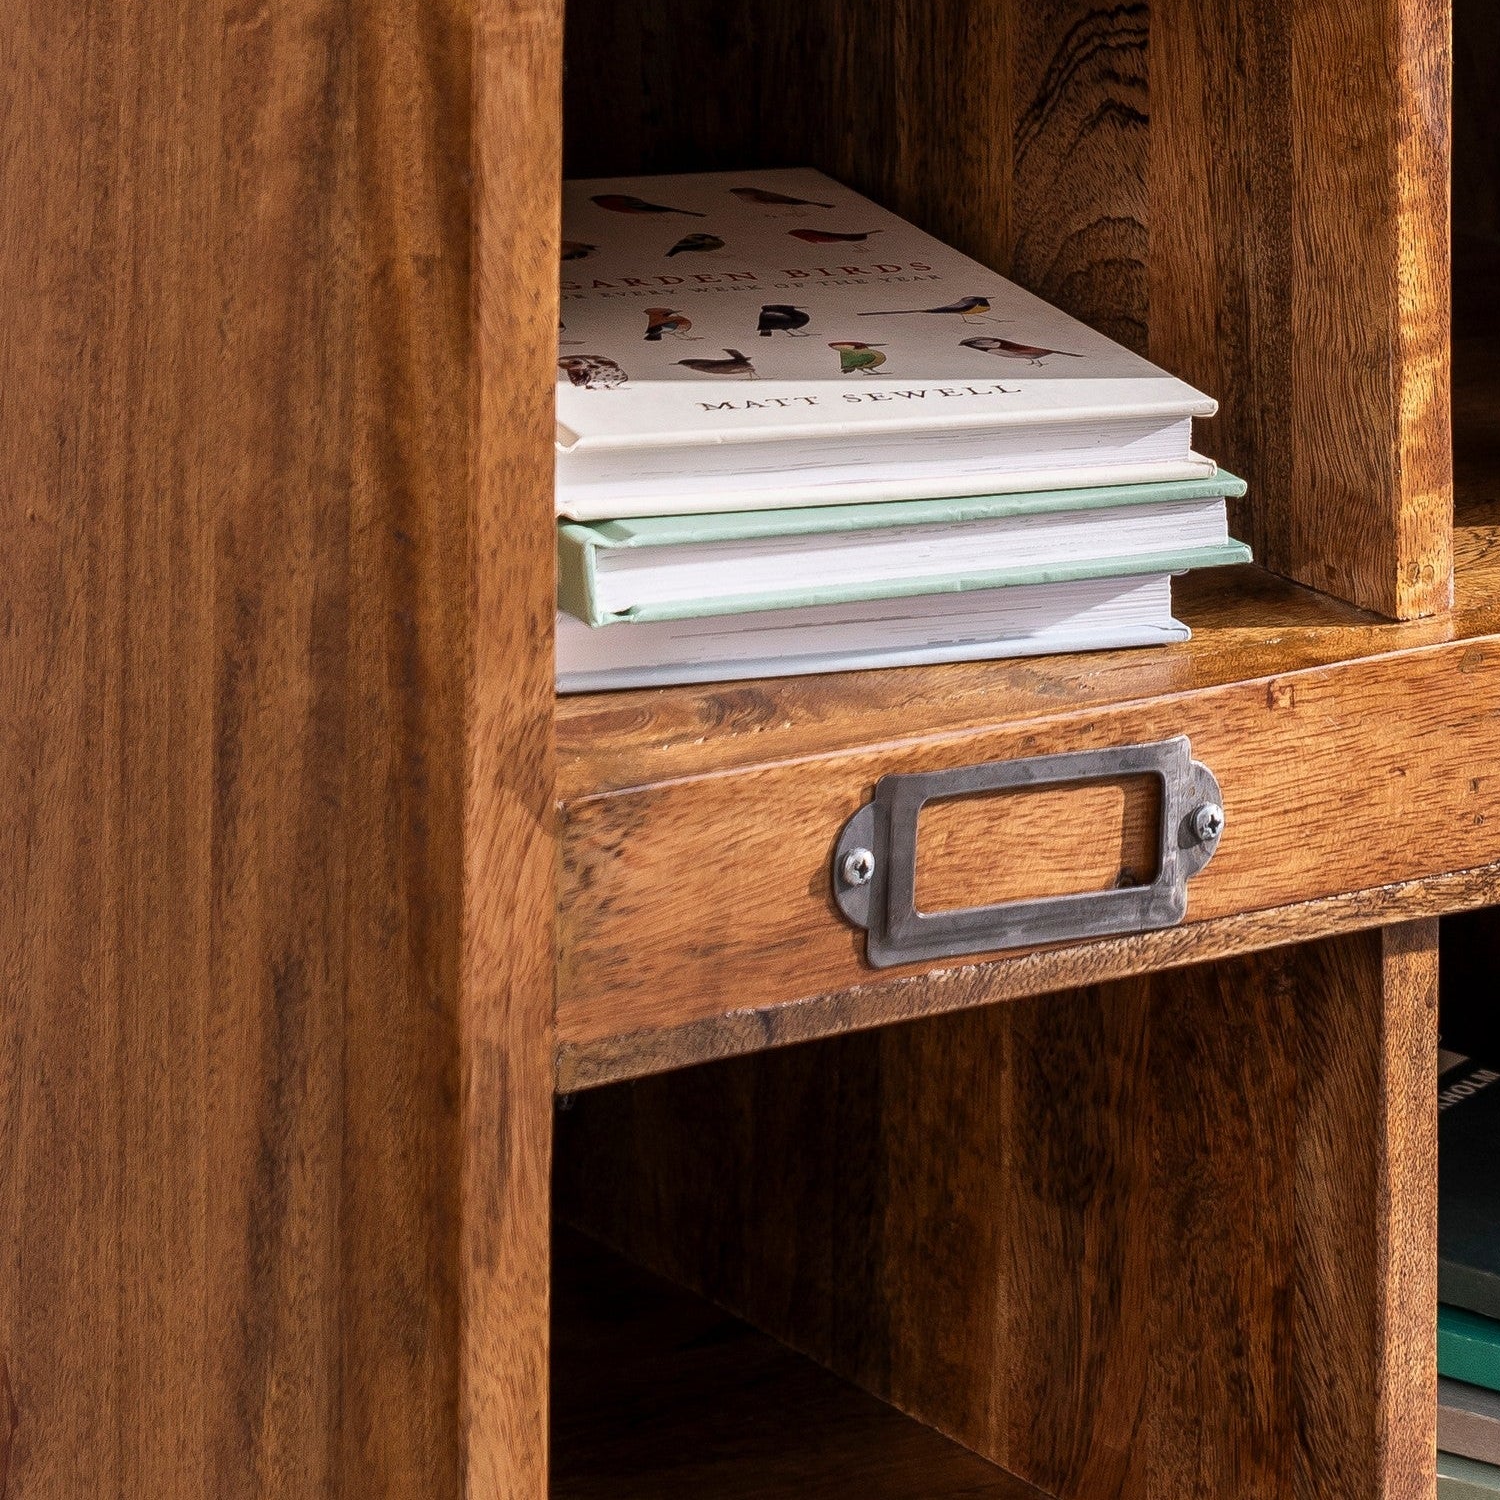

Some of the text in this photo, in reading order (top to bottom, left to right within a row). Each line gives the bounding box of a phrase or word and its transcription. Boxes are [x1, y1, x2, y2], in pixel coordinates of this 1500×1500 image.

[561, 261, 932, 291] GARDEN BIRDS
[601, 288, 676, 299] EVERY
[688, 284, 763, 293] WEEK
[816, 278, 869, 286] THE
[878, 273, 943, 283] YEAR
[695, 384, 1022, 412] MATT SEWELL
